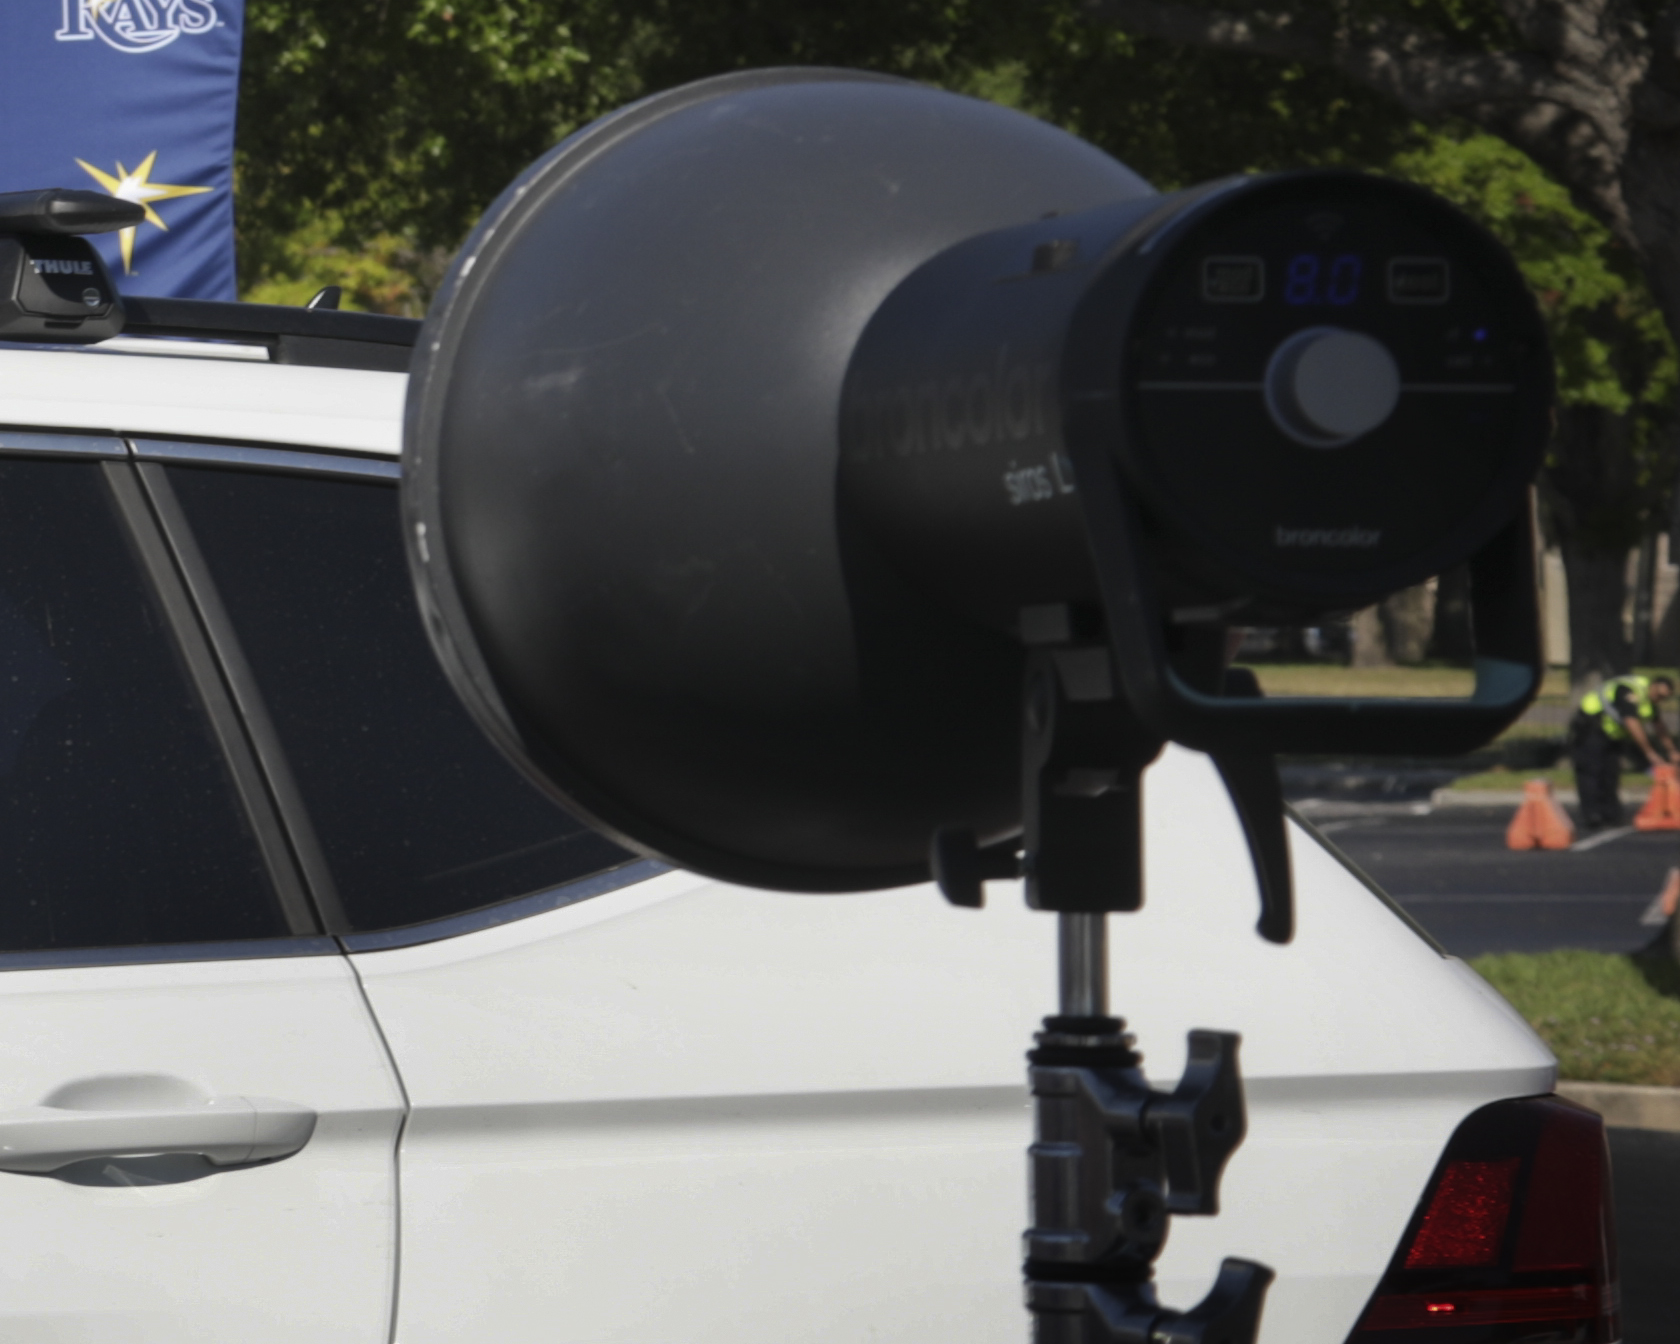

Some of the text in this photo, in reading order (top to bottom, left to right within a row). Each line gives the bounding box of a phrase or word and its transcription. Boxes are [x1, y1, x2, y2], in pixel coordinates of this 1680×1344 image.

[29, 259, 93, 275] THULE
[1283, 253, 1362, 306] 8.0
[1273, 525, 1384, 550] broncolor
